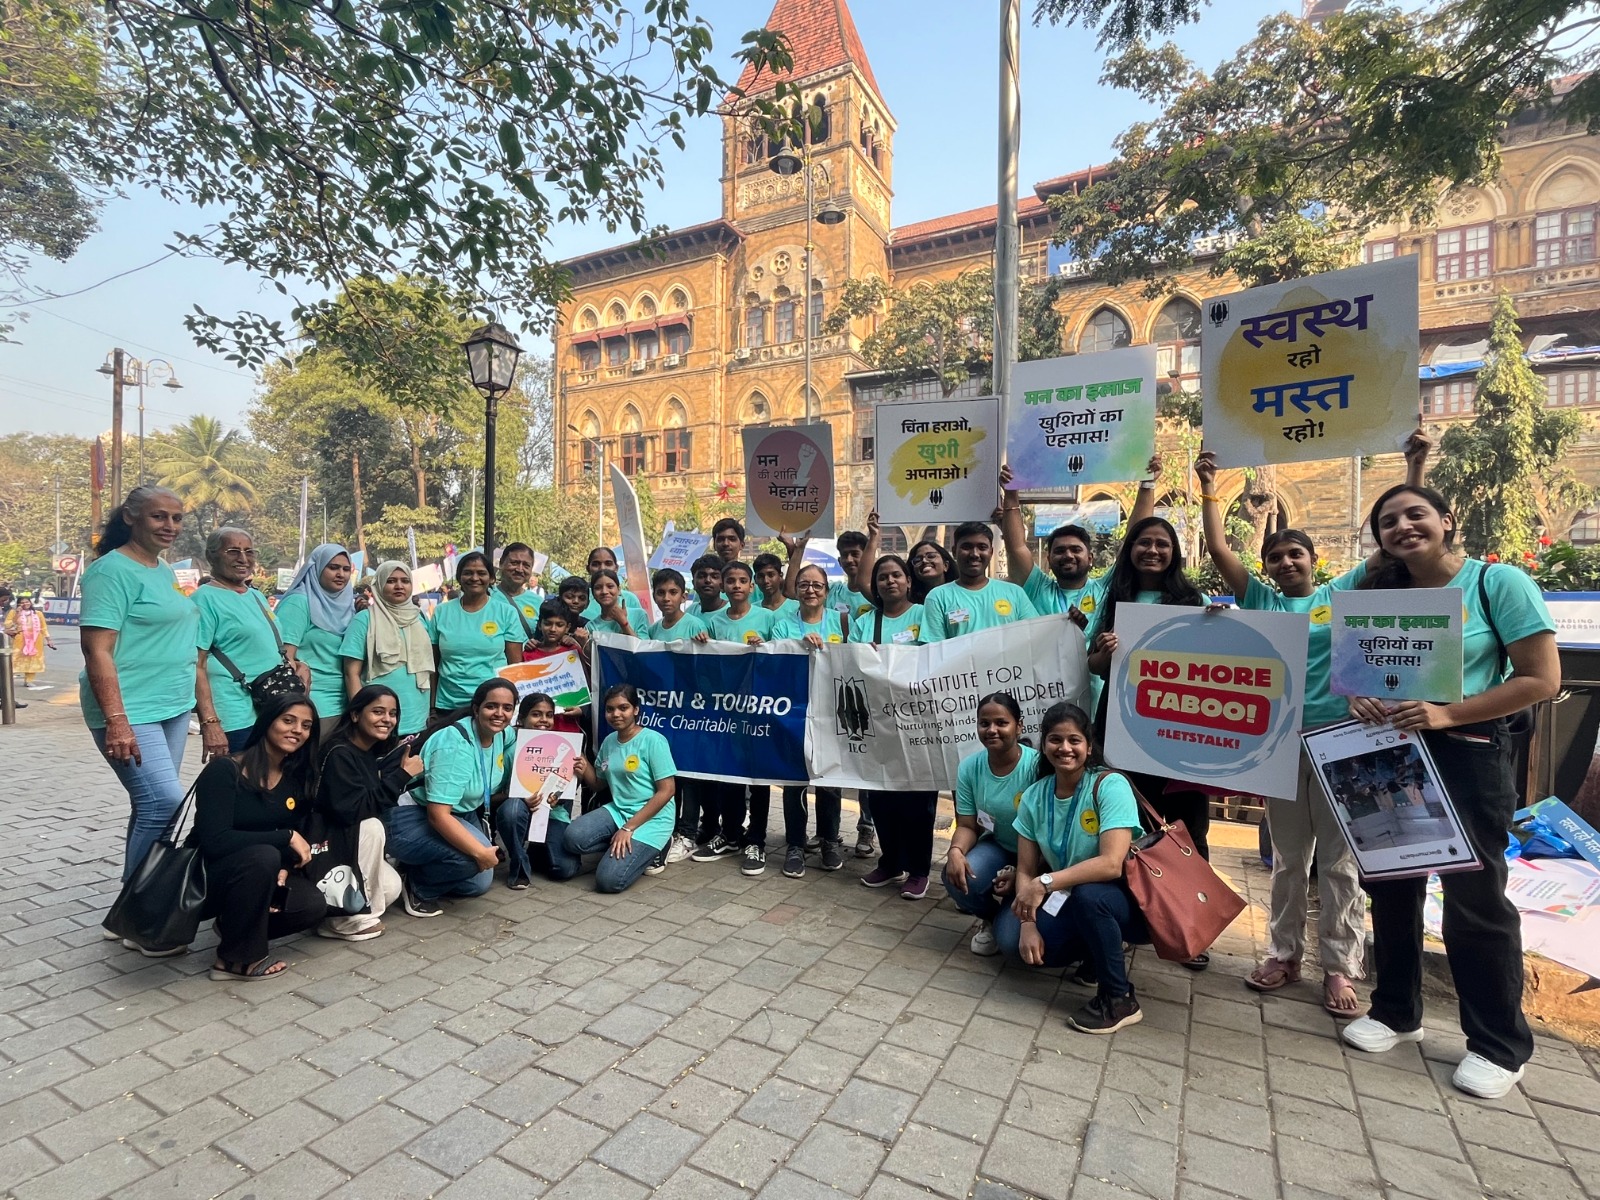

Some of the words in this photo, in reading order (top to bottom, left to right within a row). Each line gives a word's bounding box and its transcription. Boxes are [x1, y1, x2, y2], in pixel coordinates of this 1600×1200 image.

[1241, 294, 1373, 348] स्वस्थ
[1287, 344, 1321, 369] रहो
[1024, 389, 1054, 405] मन
[1055, 385, 1083, 402] का
[1085, 378, 1143, 403] इलाज
[1251, 375, 1355, 417] मस्त
[901, 419, 930, 434] चिंता
[932, 416, 972, 434] हराओ,
[1039, 408, 1096, 434] खुशियों
[1099, 409, 1124, 423] का
[1283, 419, 1325, 443] रहो!
[1045, 429, 1109, 448] एहसास!
[756, 455, 779, 467] मन
[917, 438, 959, 465] खुशी
[758, 469, 769, 480] की
[773, 467, 798, 480] शांति
[768, 482, 807, 498] मेहनत
[810, 484, 819, 496] से
[780, 497, 820, 515] कमाई
[1344, 615, 1370, 628] मन
[1371, 615, 1397, 629] का
[1398, 615, 1450, 631] इलाज
[1358, 636, 1409, 653] खुशियों
[1411, 640, 1434, 651] का
[1364, 654, 1421, 667] एहसास!
[909, 671, 979, 696] INSTITUTE
[986, 665, 1022, 686] FOR
[1140, 659, 1180, 679] NO
[1187, 663, 1271, 687] MORE
[636, 687, 684, 709] RSEN
[690, 692, 706, 710] &
[711, 693, 792, 716] TOUBRO
[996, 681, 1065, 702] HILDREN
[1147, 689, 1257, 724] TABOO!
[670, 714, 737, 734] Charitable
[741, 720, 771, 737] Trust
[895, 720, 943, 731] Nurturing
[1026, 707, 1047, 717] Live
[848, 742, 867, 754] IEC
[909, 736, 933, 746] REGN
[935, 736, 952, 745] NO.
[954, 732, 977, 743] BOM
[1156, 728, 1241, 750] #LETSTALK!
[526, 746, 543, 754] मन
[531, 763, 560, 774] मेहनत
